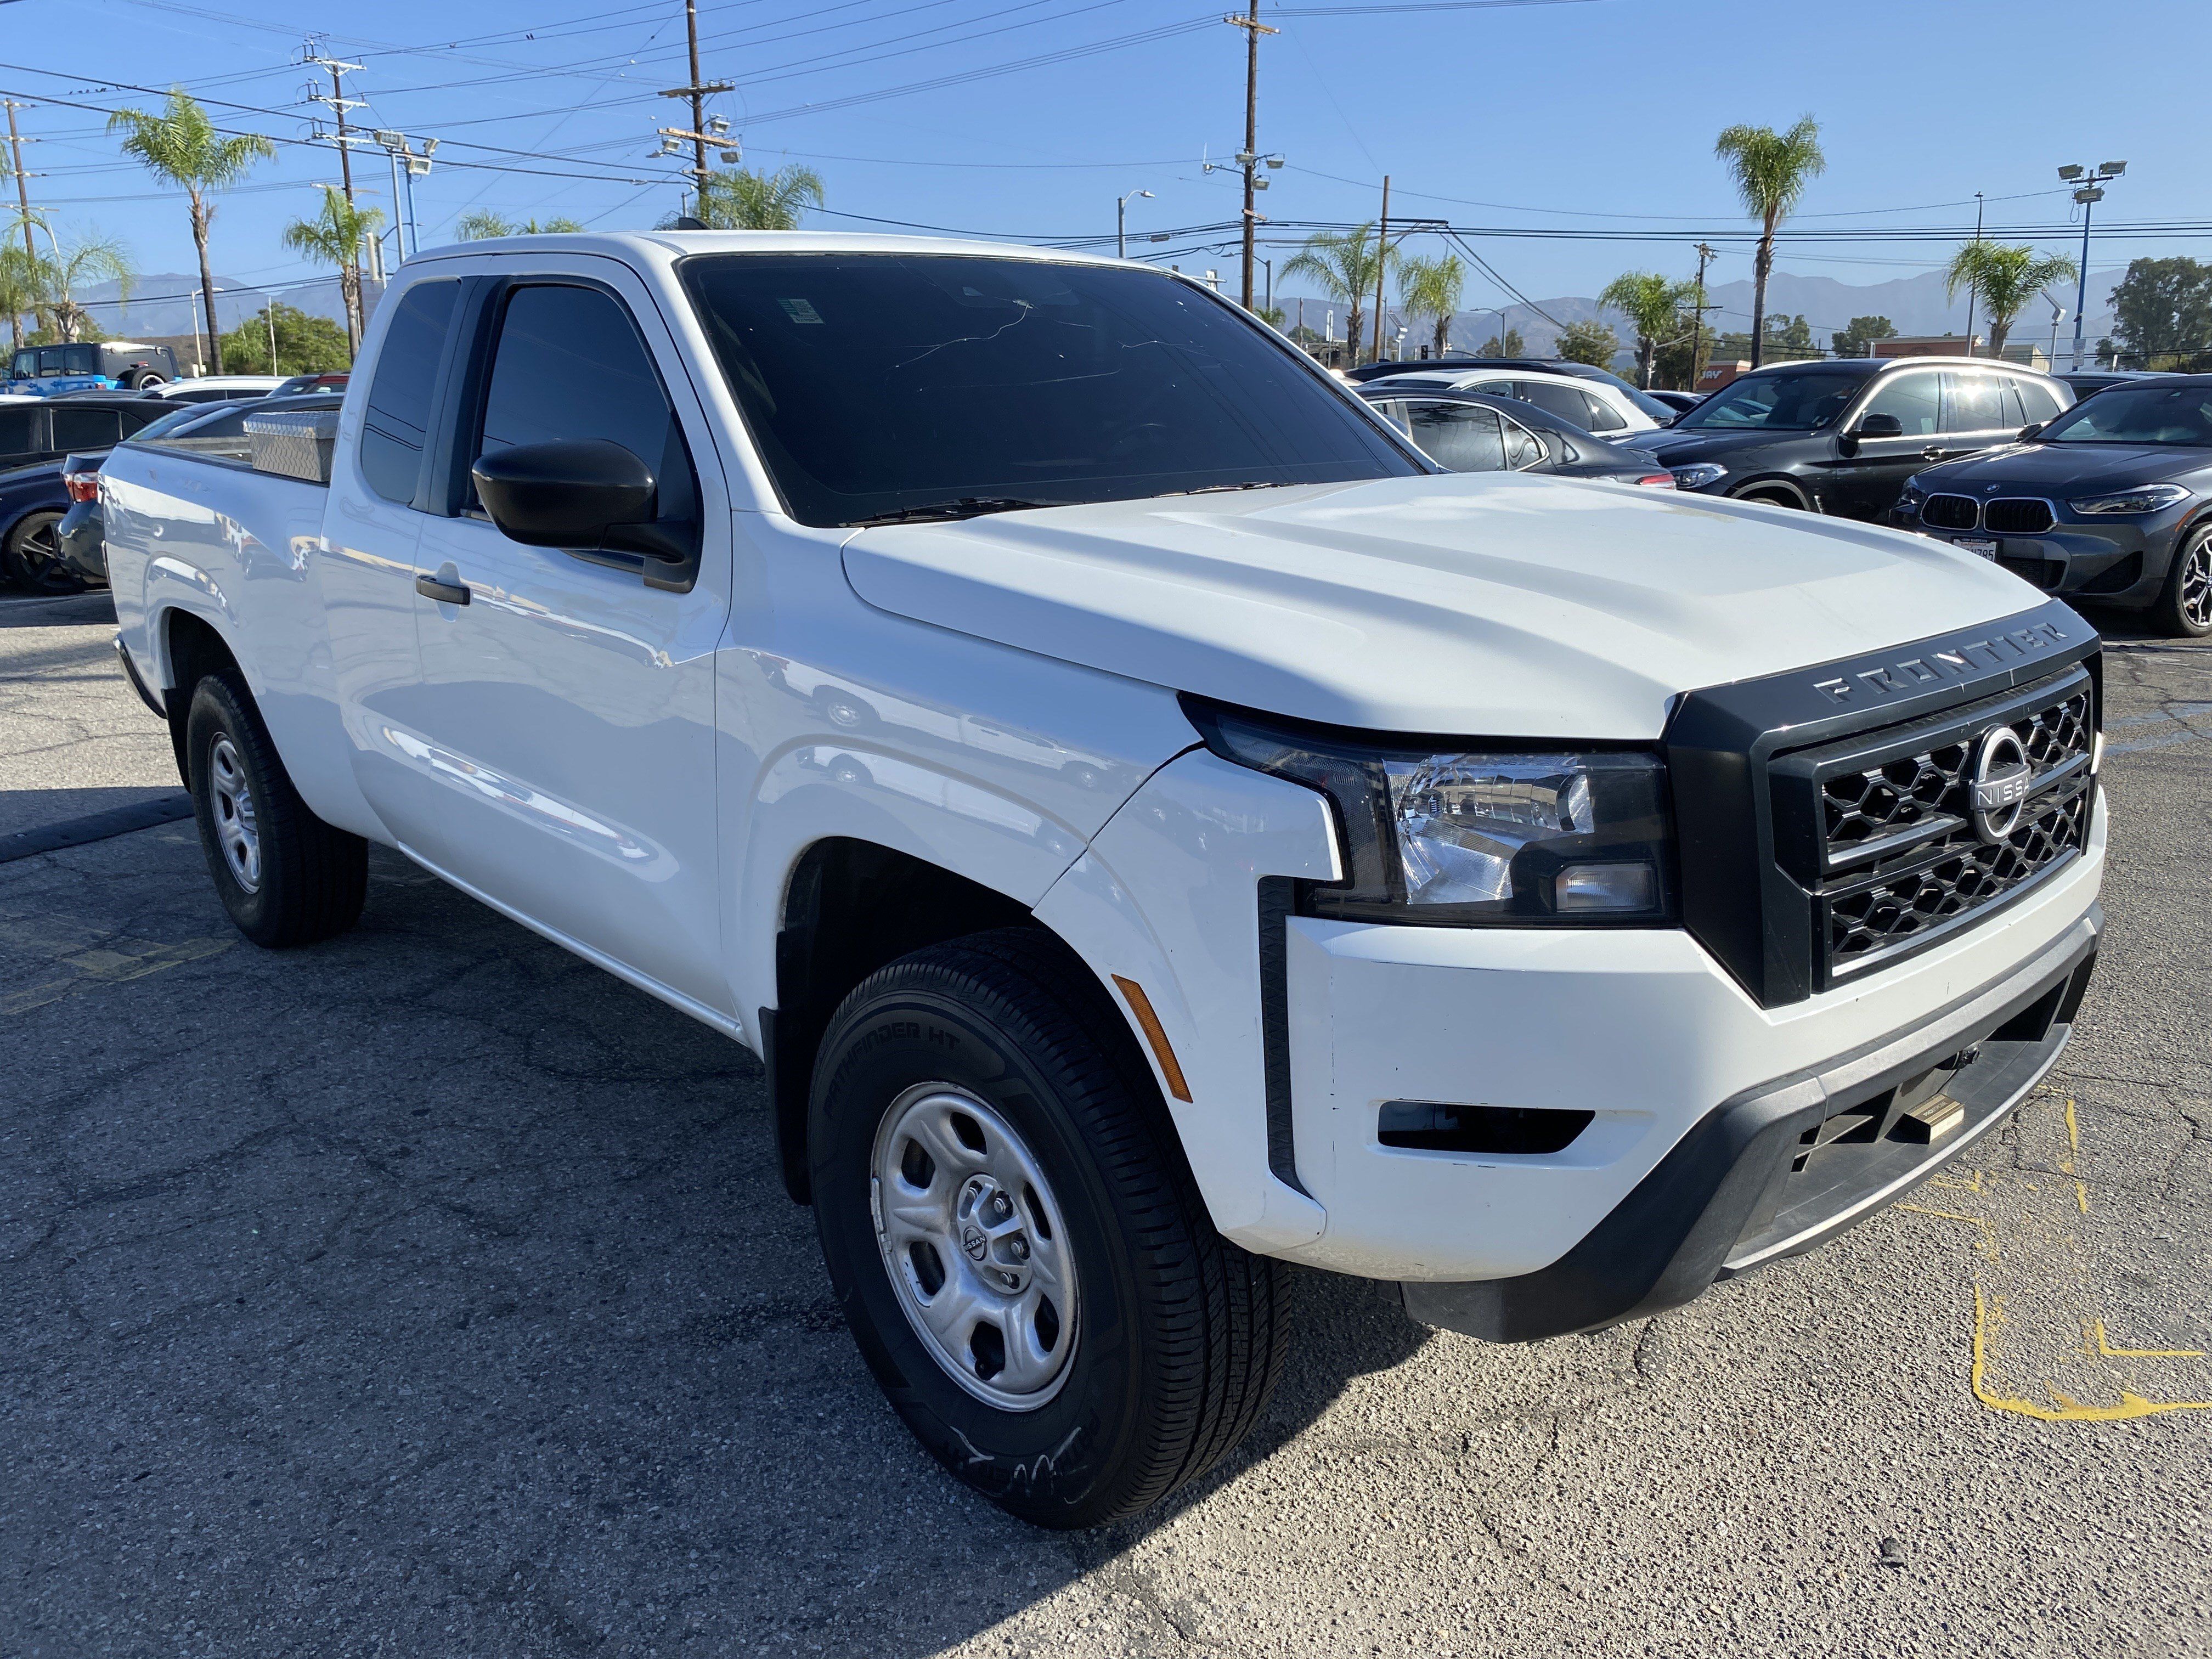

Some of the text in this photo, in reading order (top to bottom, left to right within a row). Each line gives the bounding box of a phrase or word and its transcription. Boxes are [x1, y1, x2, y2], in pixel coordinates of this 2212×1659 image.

[1813, 622, 2069, 704] FRONTIER
[1977, 777, 2030, 806] NISSA
[929, 1026, 960, 1051] HT
